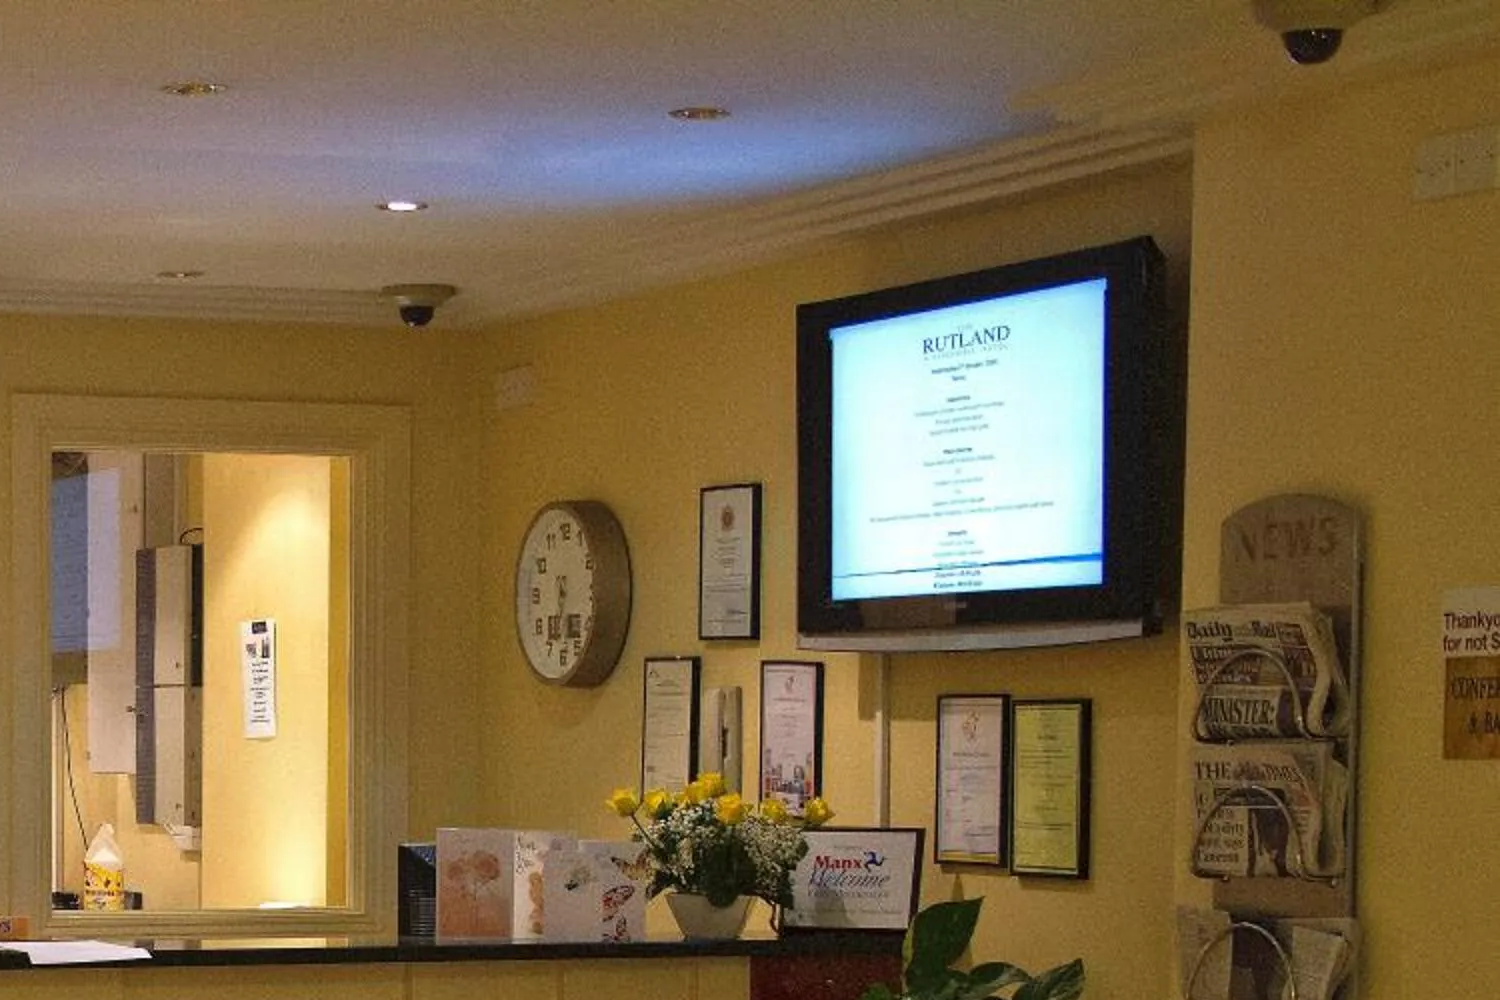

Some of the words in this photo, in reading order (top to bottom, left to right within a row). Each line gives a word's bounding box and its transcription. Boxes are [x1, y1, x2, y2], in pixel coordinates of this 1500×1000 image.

[923, 325, 1011, 354] RUTLAND
[560, 523, 571, 541] 12
[1234, 514, 1337, 563] NEWS
[1443, 635, 1462, 651] for
[1465, 634, 1487, 650] not
[1195, 761, 1232, 780] THE
[813, 855, 862, 870] Manx
